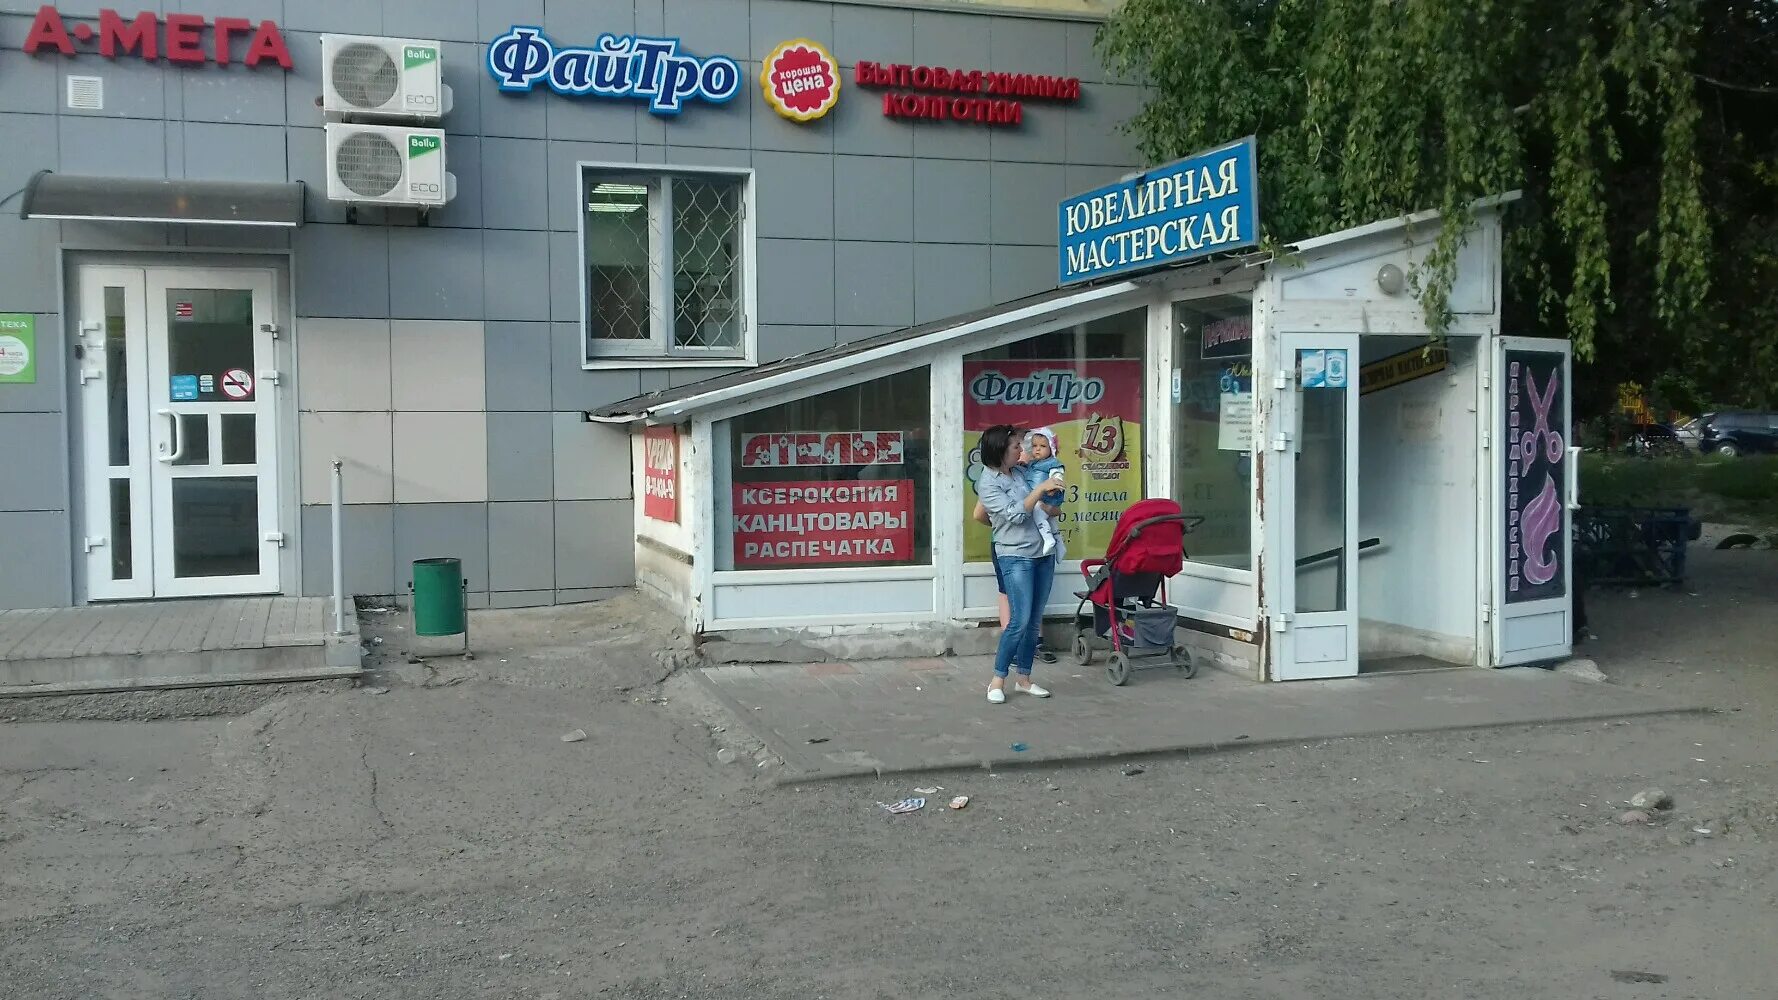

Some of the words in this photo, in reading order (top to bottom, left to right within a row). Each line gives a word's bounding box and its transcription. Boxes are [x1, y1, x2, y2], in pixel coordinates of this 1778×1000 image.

[407, 49, 430, 59] Ballu
[490, 28, 738, 111] ФайТро
[780, 65, 822, 79] хорошая
[856, 61, 983, 92] БЫТОВАЯ
[987, 72, 1080, 99] ХИМИЯ
[782, 74, 825, 96] цена
[406, 94, 434, 105] ECO
[883, 93, 1022, 123] КОЛГОТКИ
[411, 138, 435, 148] Ballu
[410, 182, 439, 192] ECO
[1066, 158, 1239, 236] ЮВЕЛИРНАЯ
[1066, 205, 1240, 276] МАСТЕРСКАЯ
[972, 373, 1102, 410] ФайТро
[743, 431, 901, 465] АТЕЛЬЕ
[1081, 423, 1118, 454] 13
[1509, 361, 1521, 592] ПАРИКМАХЕРСКАЯ
[742, 486, 898, 505] КСЕРОКОПИЯ
[1084, 491, 1128, 502] числа
[733, 511, 907, 535] КАНЦТОВАРЫ
[1071, 511, 1122, 523] месяц
[745, 538, 895, 558] РАСПЕЧАТКА
